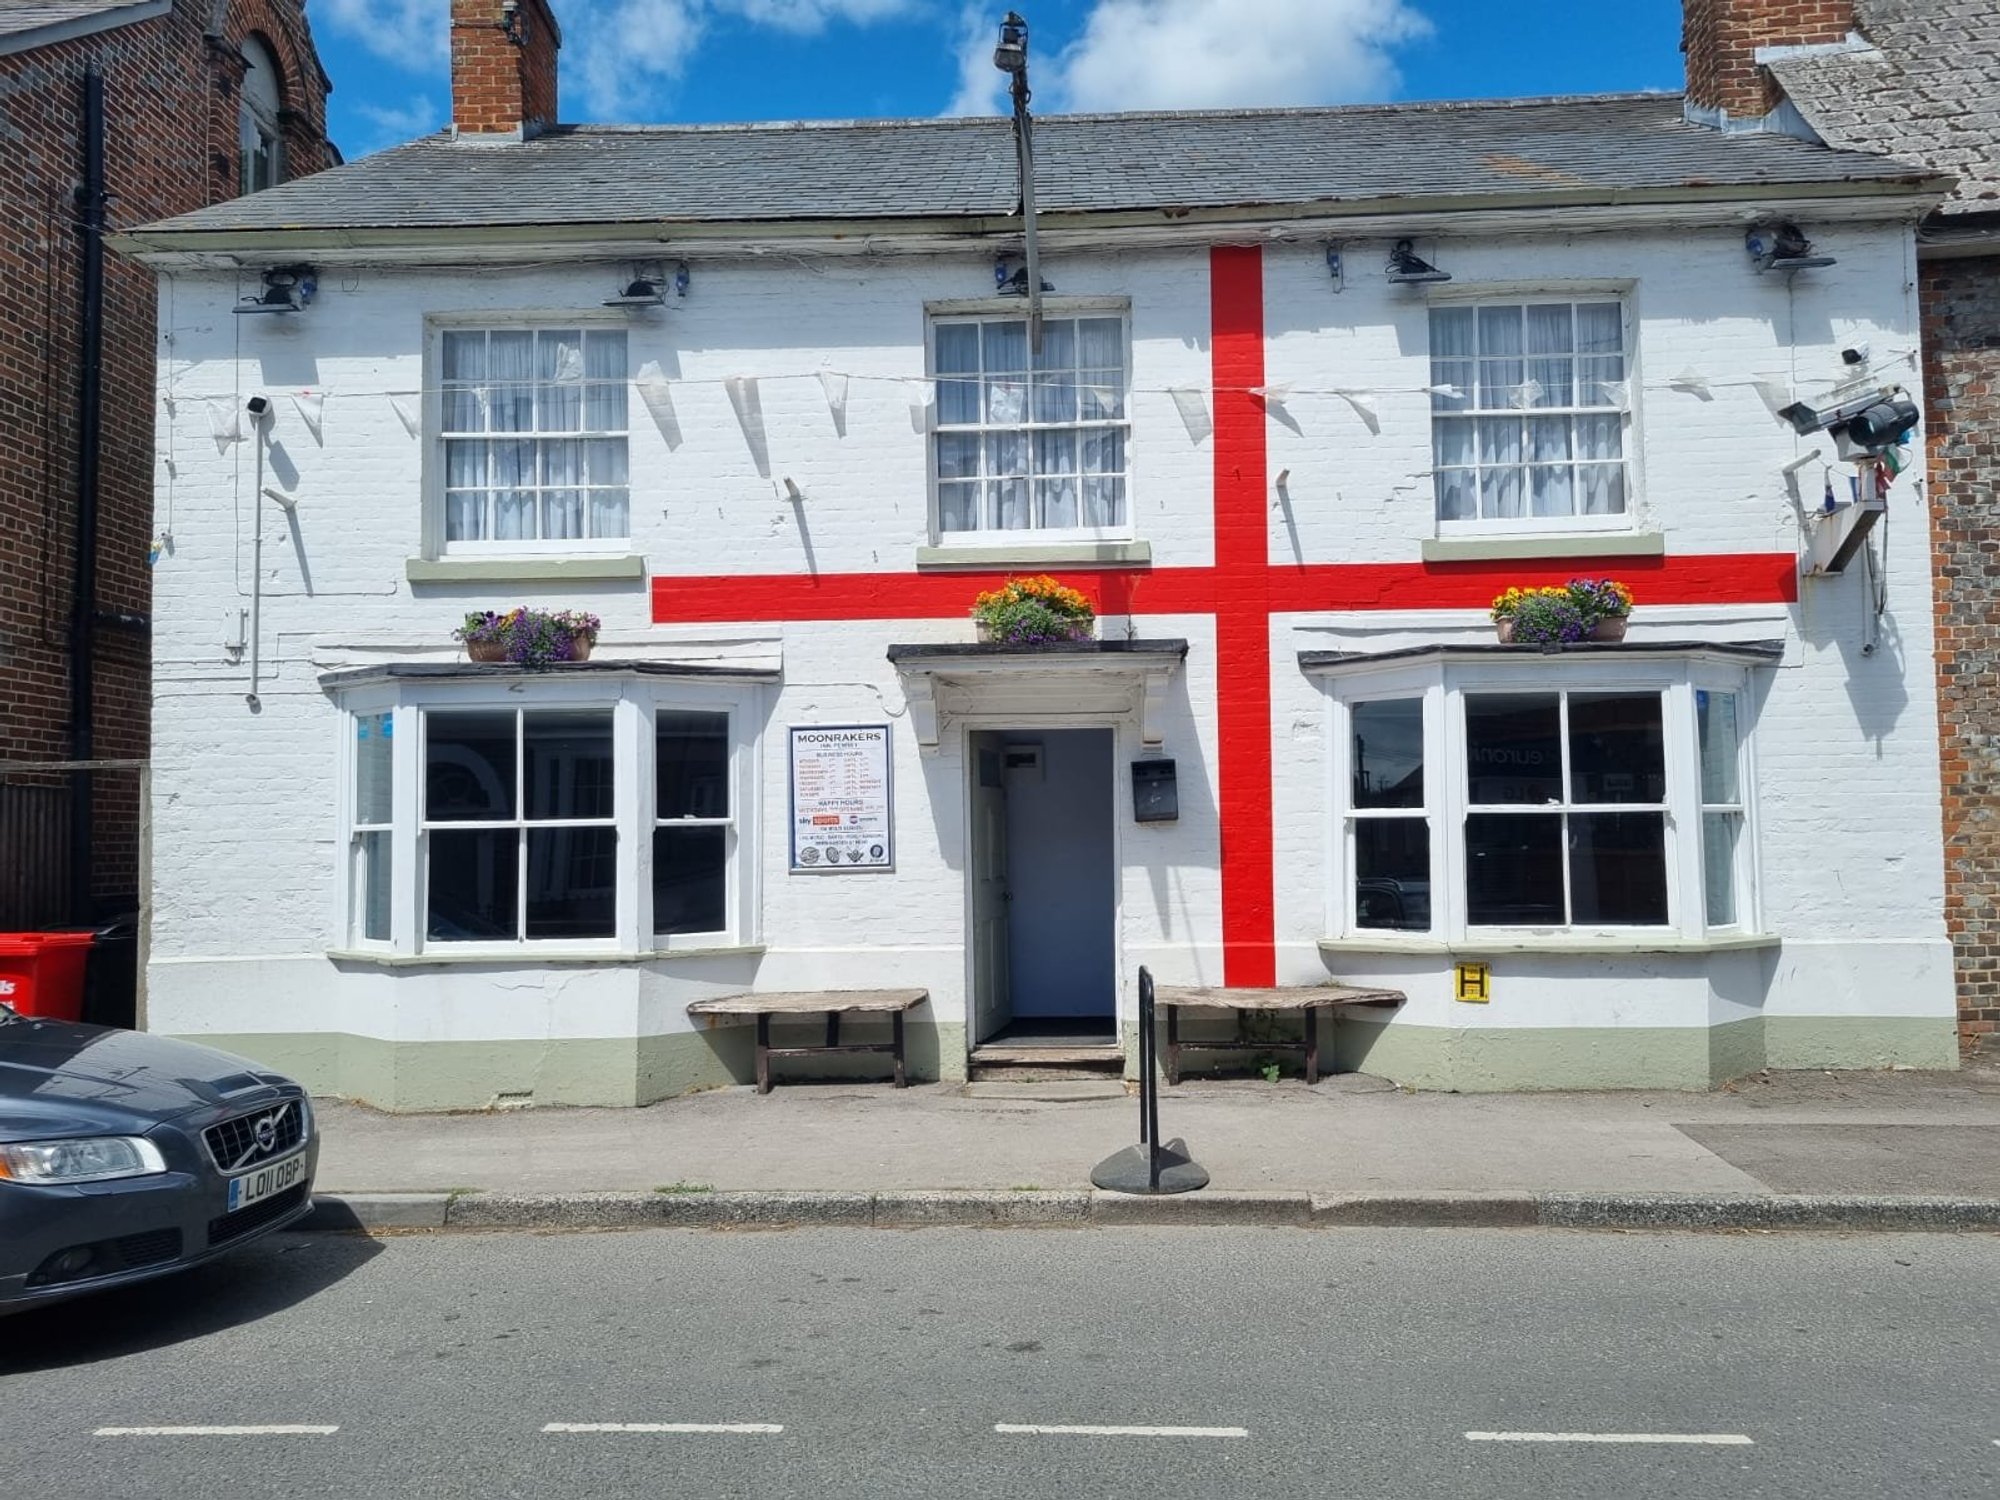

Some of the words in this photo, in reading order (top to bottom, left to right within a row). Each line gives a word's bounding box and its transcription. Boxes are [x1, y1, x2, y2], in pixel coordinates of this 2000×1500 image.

[798, 732, 881, 743] MOONRAKERS
[1460, 967, 1485, 997] H
[245, 1169, 274, 1201] LO11
[276, 1158, 300, 1189] OBP
